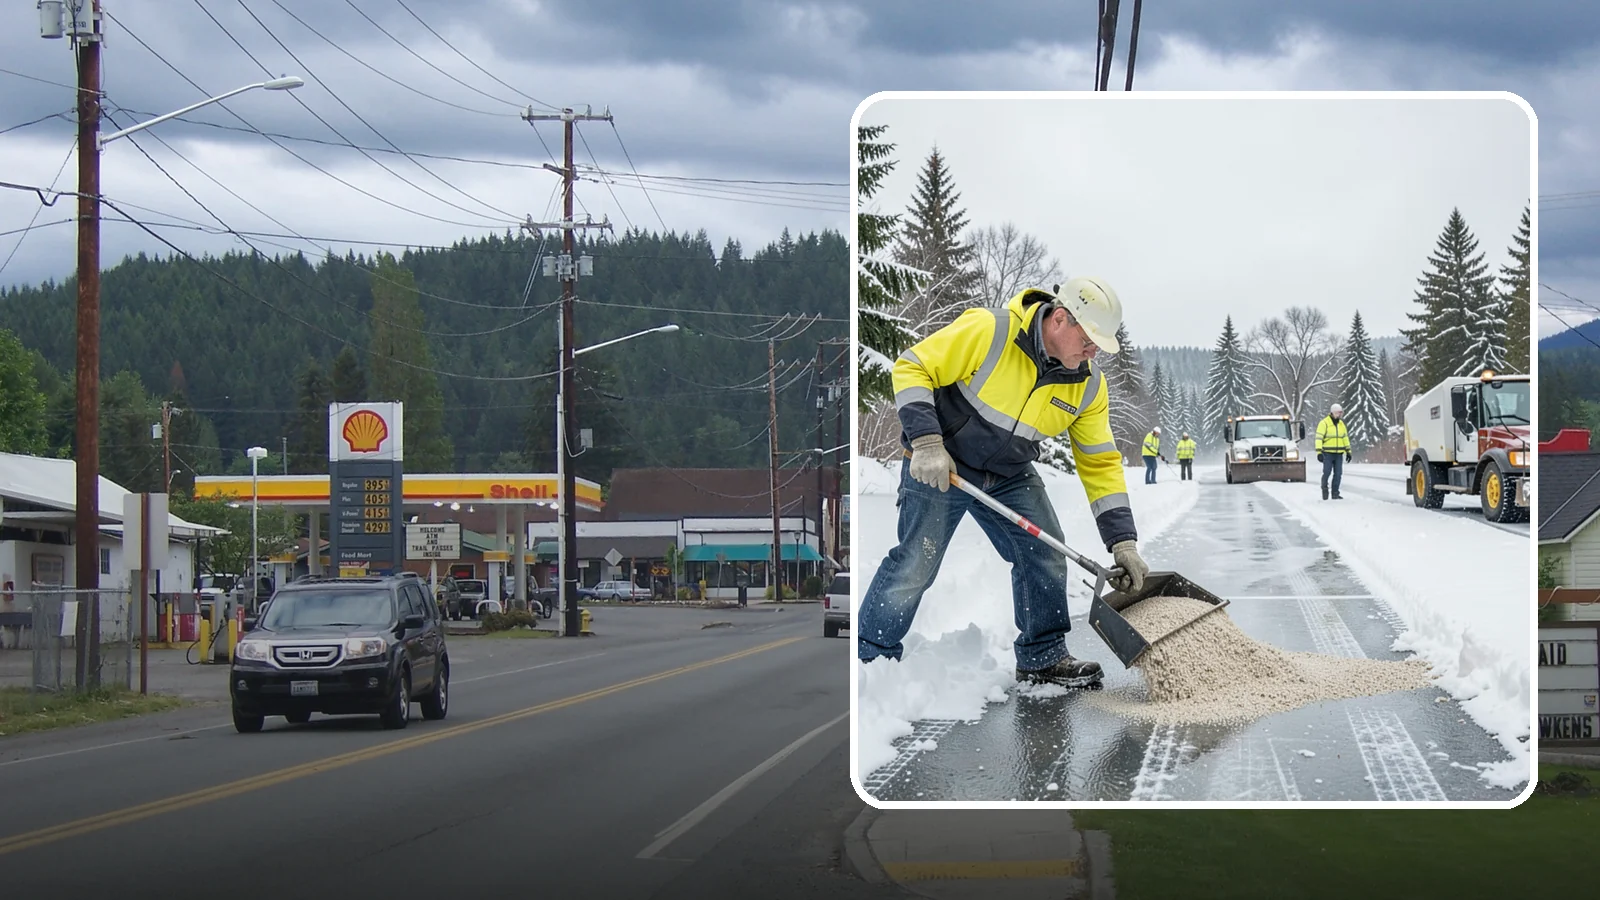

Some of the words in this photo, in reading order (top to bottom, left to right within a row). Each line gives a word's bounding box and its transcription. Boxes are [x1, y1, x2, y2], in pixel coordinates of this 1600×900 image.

[366, 480, 383, 490] 395
[490, 484, 547, 499] Shell
[366, 494, 383, 504] 405
[366, 508, 383, 518] 415
[366, 522, 383, 532] 429
